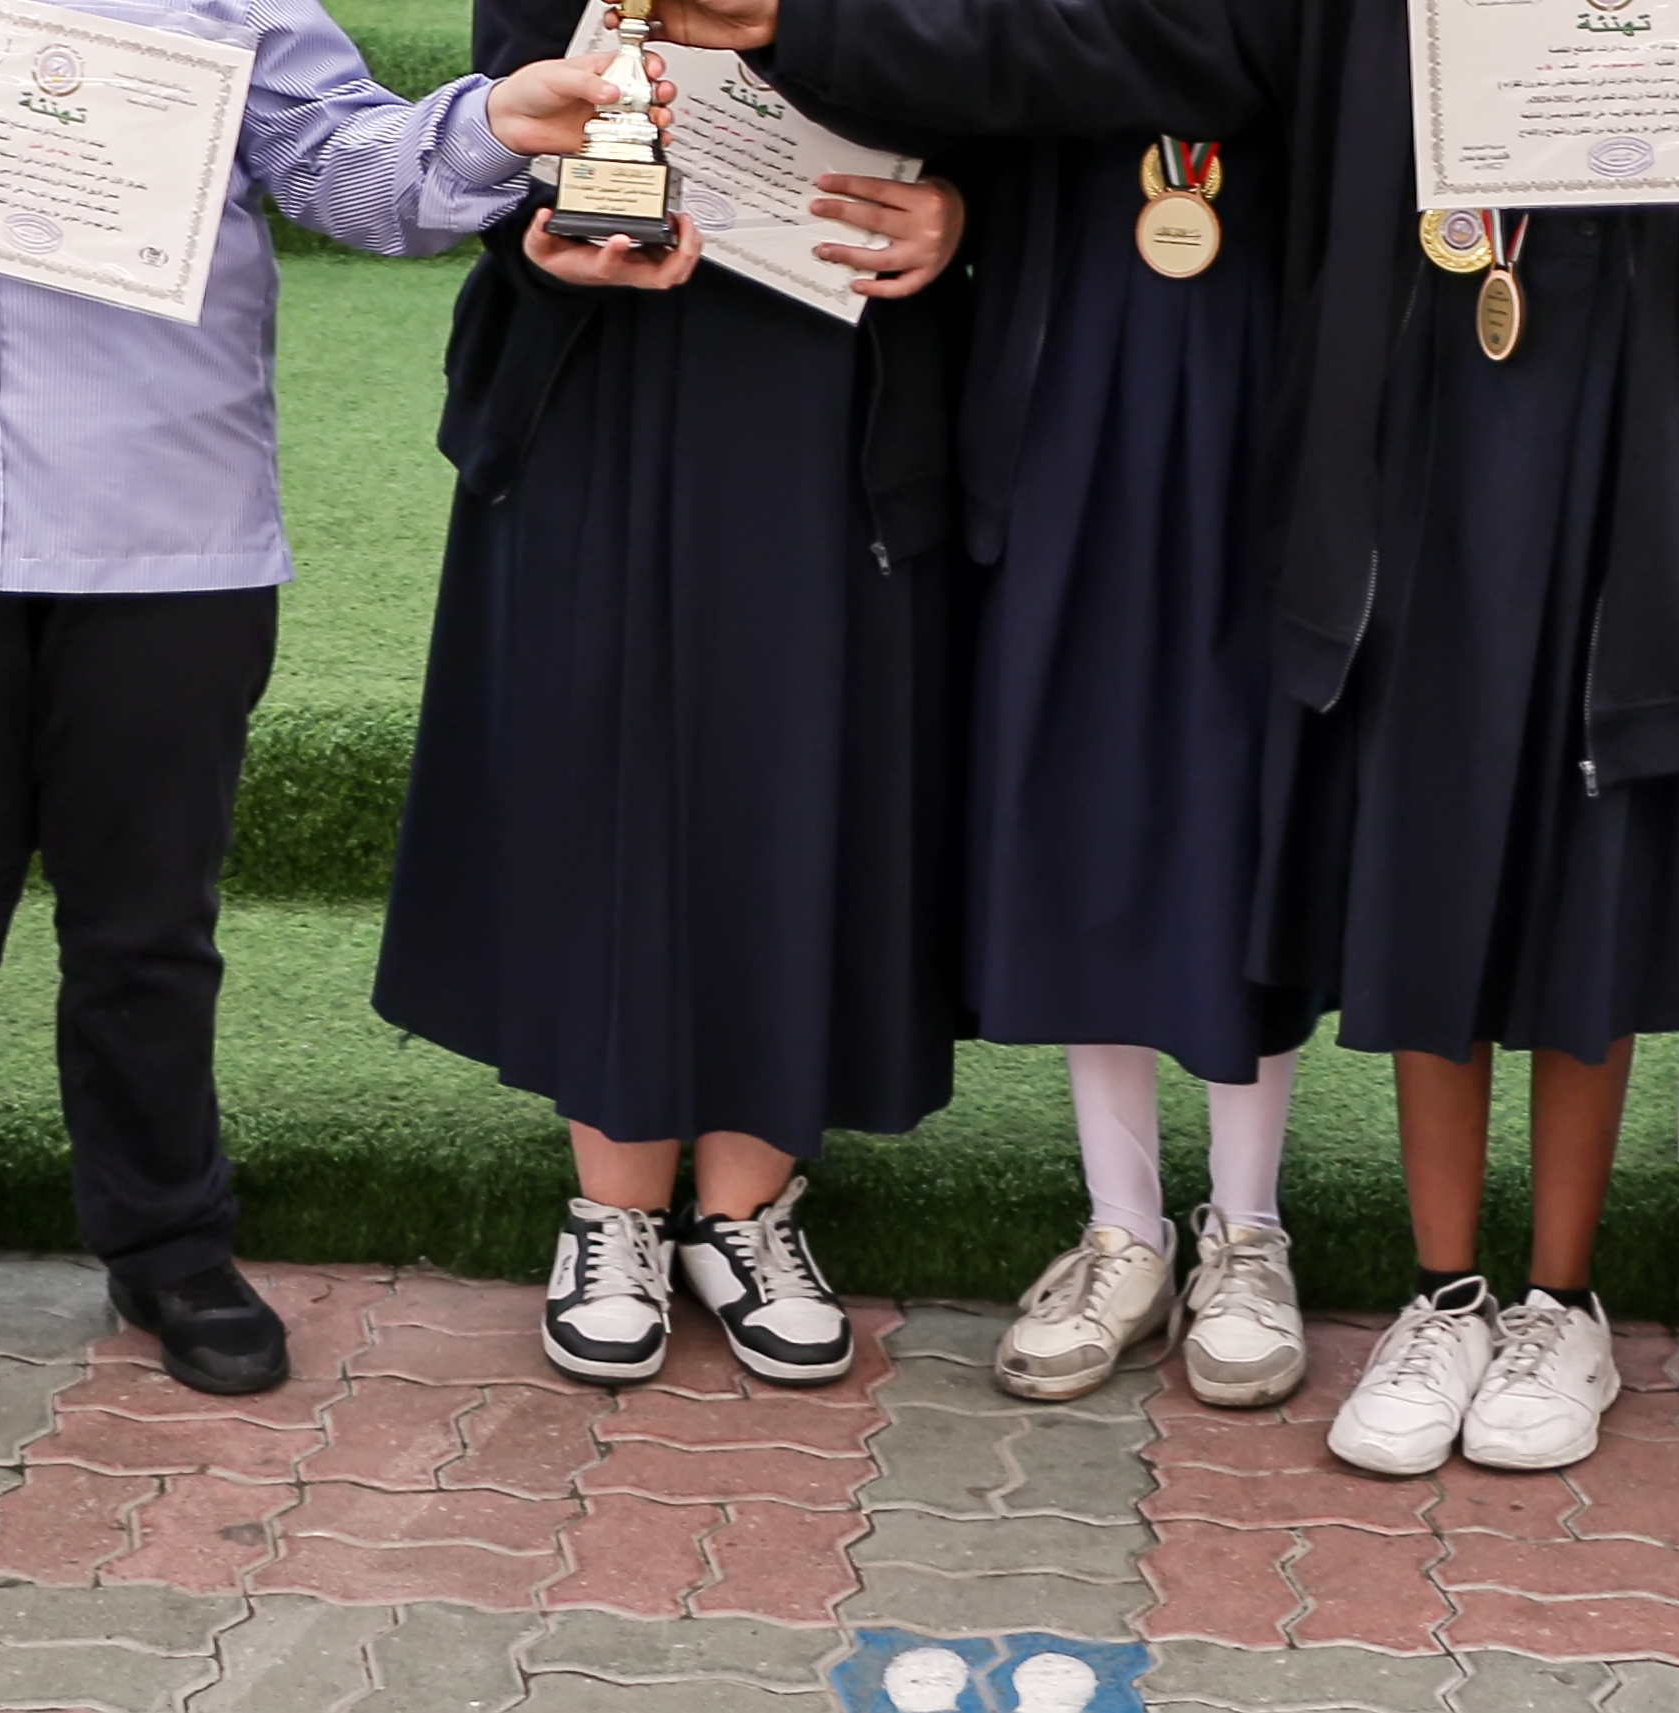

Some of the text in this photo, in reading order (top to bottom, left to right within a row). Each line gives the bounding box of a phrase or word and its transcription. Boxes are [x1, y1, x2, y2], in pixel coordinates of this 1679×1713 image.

[1577, 13, 1652, 36] تهنئة
[18, 91, 87, 125] تهنئة
[720, 79, 786, 121] تهنئة
